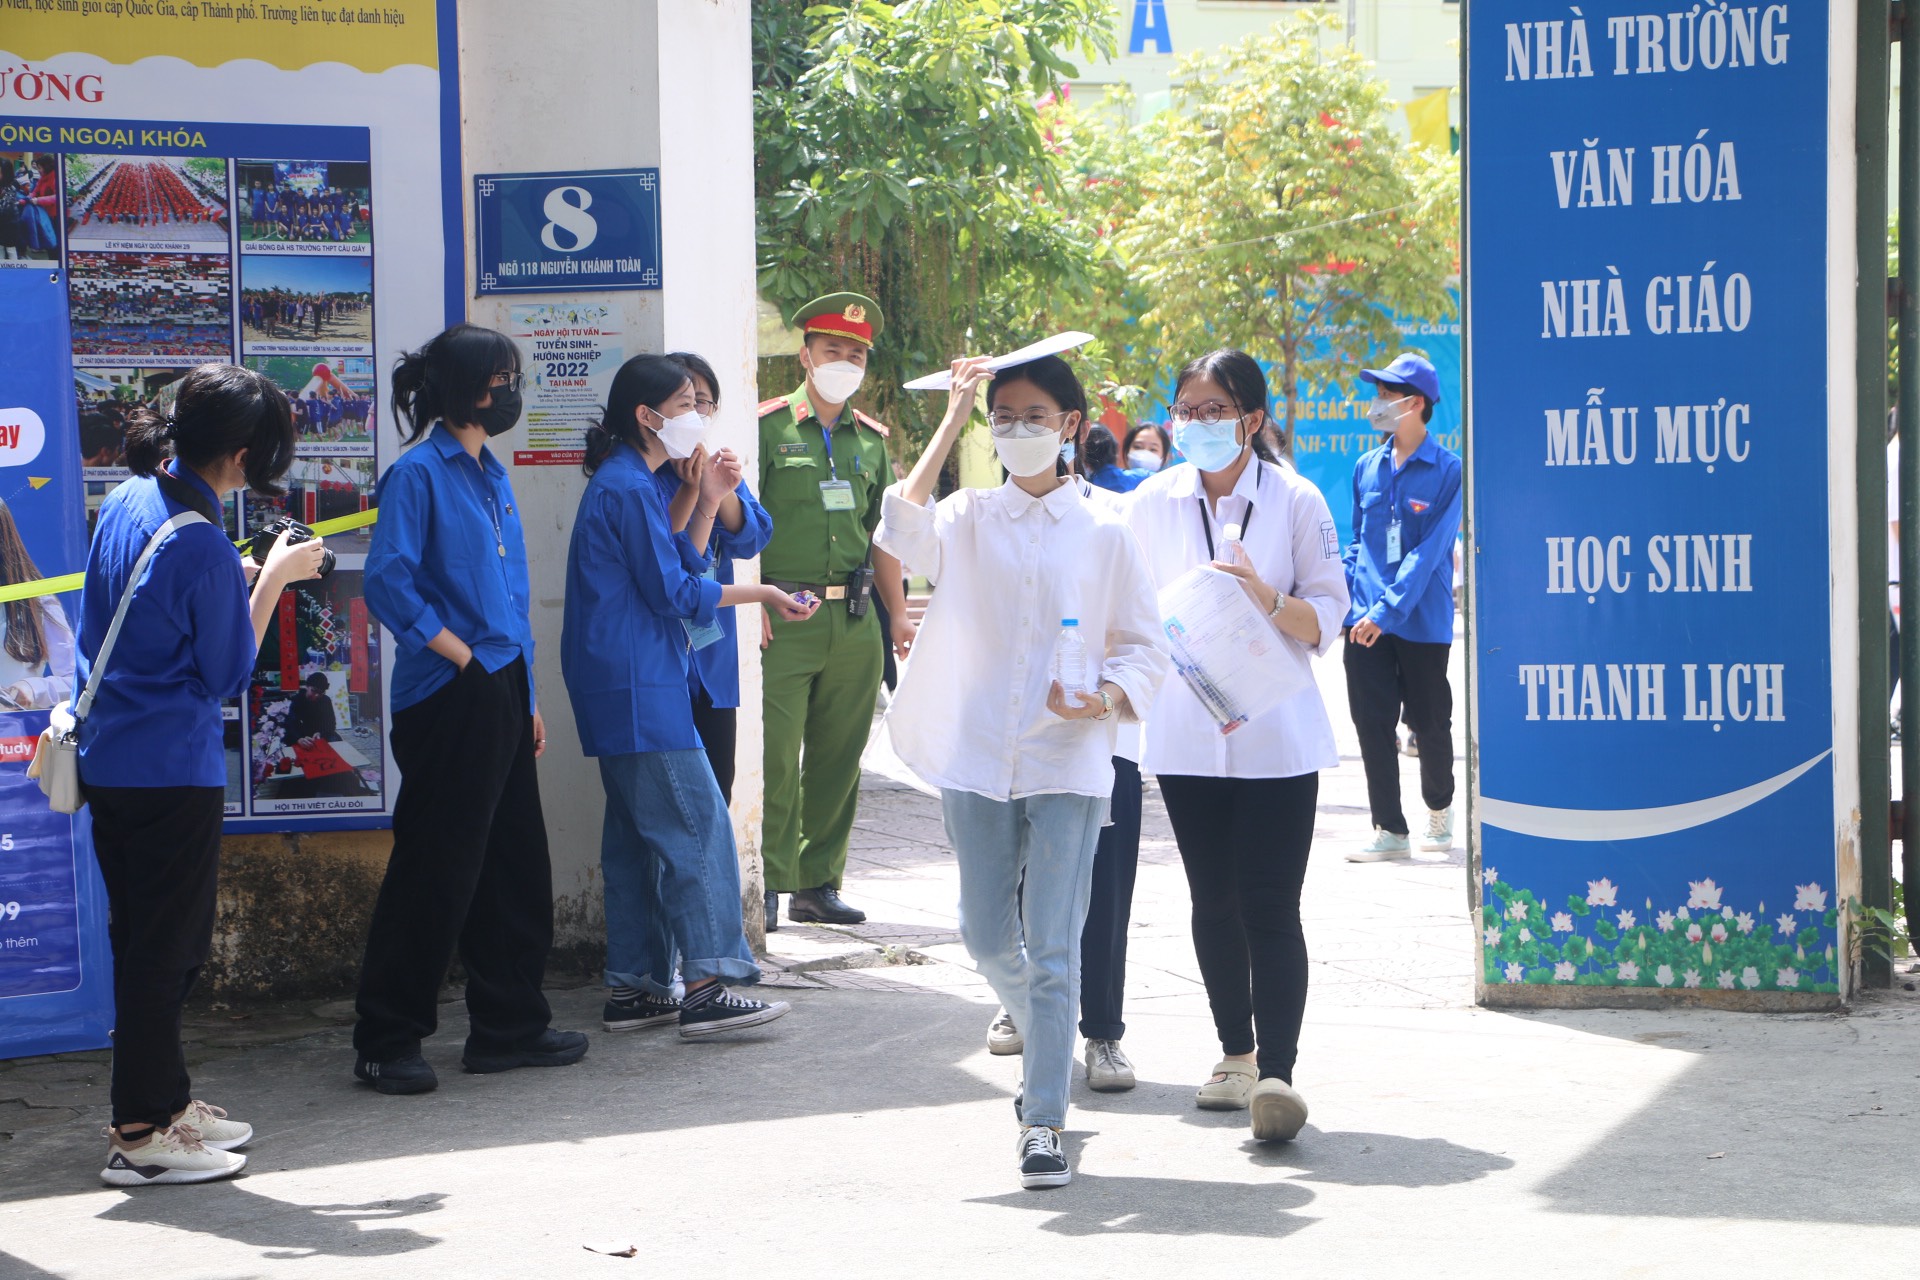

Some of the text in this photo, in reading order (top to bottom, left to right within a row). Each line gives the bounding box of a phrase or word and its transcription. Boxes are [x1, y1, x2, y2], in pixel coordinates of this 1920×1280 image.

[201, 3, 233, 18] Thành
[260, 4, 298, 25] Trường
[300, 6, 320, 21] liên
[321, 8, 337, 25] tục
[339, 8, 355, 25] đạt
[357, 8, 381, 24] danh
[383, 9, 405, 27] hiệu
[1129, 0, 1173, 53] A
[1505, 0, 1790, 81] NHÀ TRƯỜNG
[60, 127, 134, 149] NGOẠI
[141, 127, 207, 148] KHÓA
[1550, 128, 1742, 209] VĂN HÓA
[541, 186, 598, 252] 8
[296, 244, 321, 252] TRƯỜNG
[499, 255, 641, 276] NGÕ 118 NGUYỄN KHÁNH TOÀN
[1541, 261, 1751, 338] NHÀ GIÁO
[534, 326, 599, 338] NGÀY HỘI TƯ VẤN
[536, 337, 568, 349] TUYỂN
[570, 340, 592, 349] SINH
[533, 349, 601, 362] HƯỚNG NGHIỆP
[546, 362, 589, 377] 2022
[549, 379, 586, 388] TẠI HÀ NỘI
[1275, 397, 1315, 419] CÚC
[1318, 396, 1348, 419] CÁC
[1544, 387, 1750, 474] MẪU MỰC
[1545, 534, 1753, 604] HỌC SINH
[1518, 663, 1786, 732] THANH LỊCH
[275, 803, 289, 811] HỘI
[307, 801, 325, 809] VIẾT
[348, 799, 363, 808] ĐỐI
[6, 936, 38, 949] thêm
